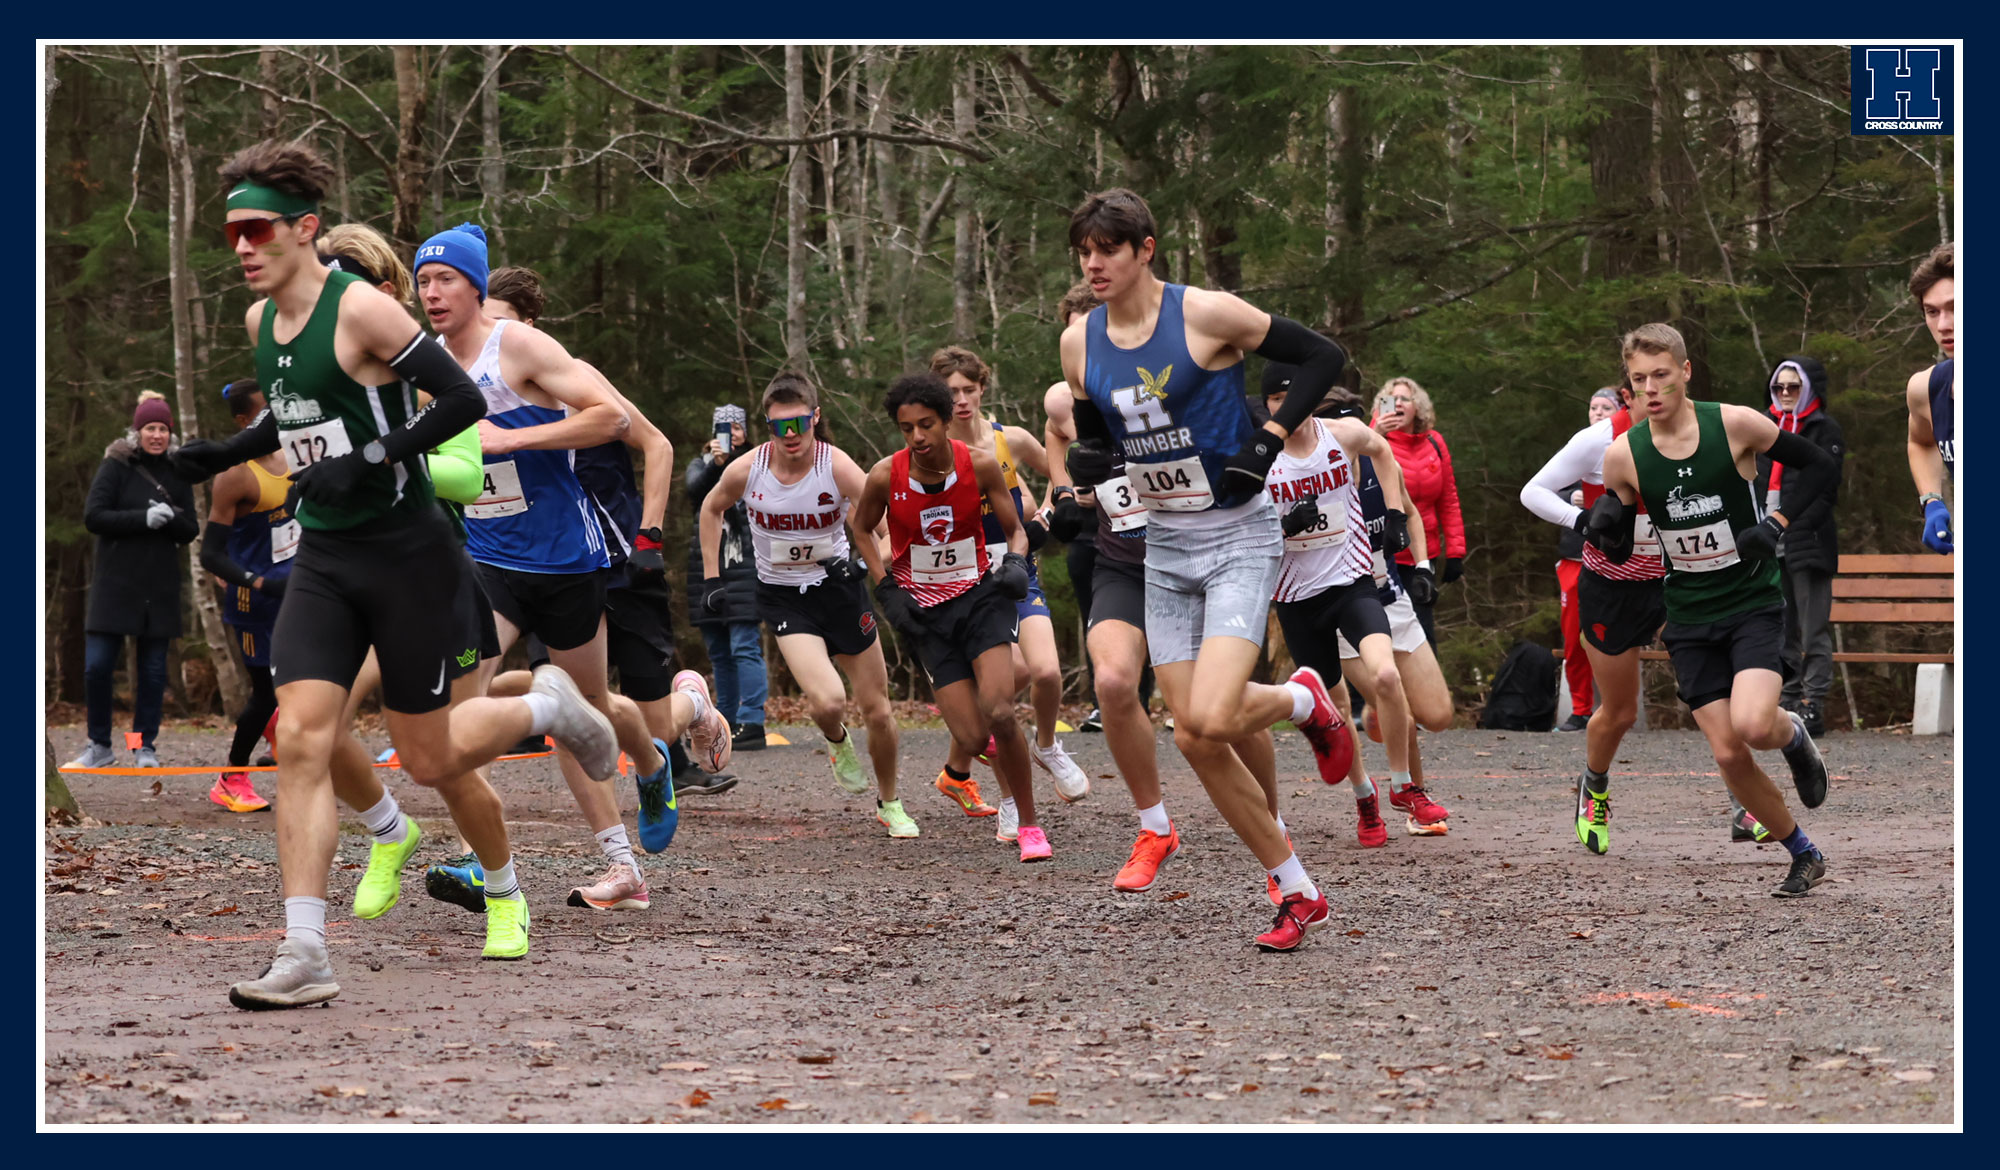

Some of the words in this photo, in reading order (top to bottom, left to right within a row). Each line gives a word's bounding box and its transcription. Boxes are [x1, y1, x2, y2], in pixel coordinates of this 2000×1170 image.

[290, 435, 333, 467] 172
[1122, 427, 1195, 457] HUMBER
[1143, 468, 1191, 492] 104
[1269, 463, 1349, 504] FANSHAWE
[922, 510, 950, 521] TROJANS
[789, 545, 814, 561] 97
[1675, 531, 1719, 555] 174
[931, 549, 957, 568] 75
